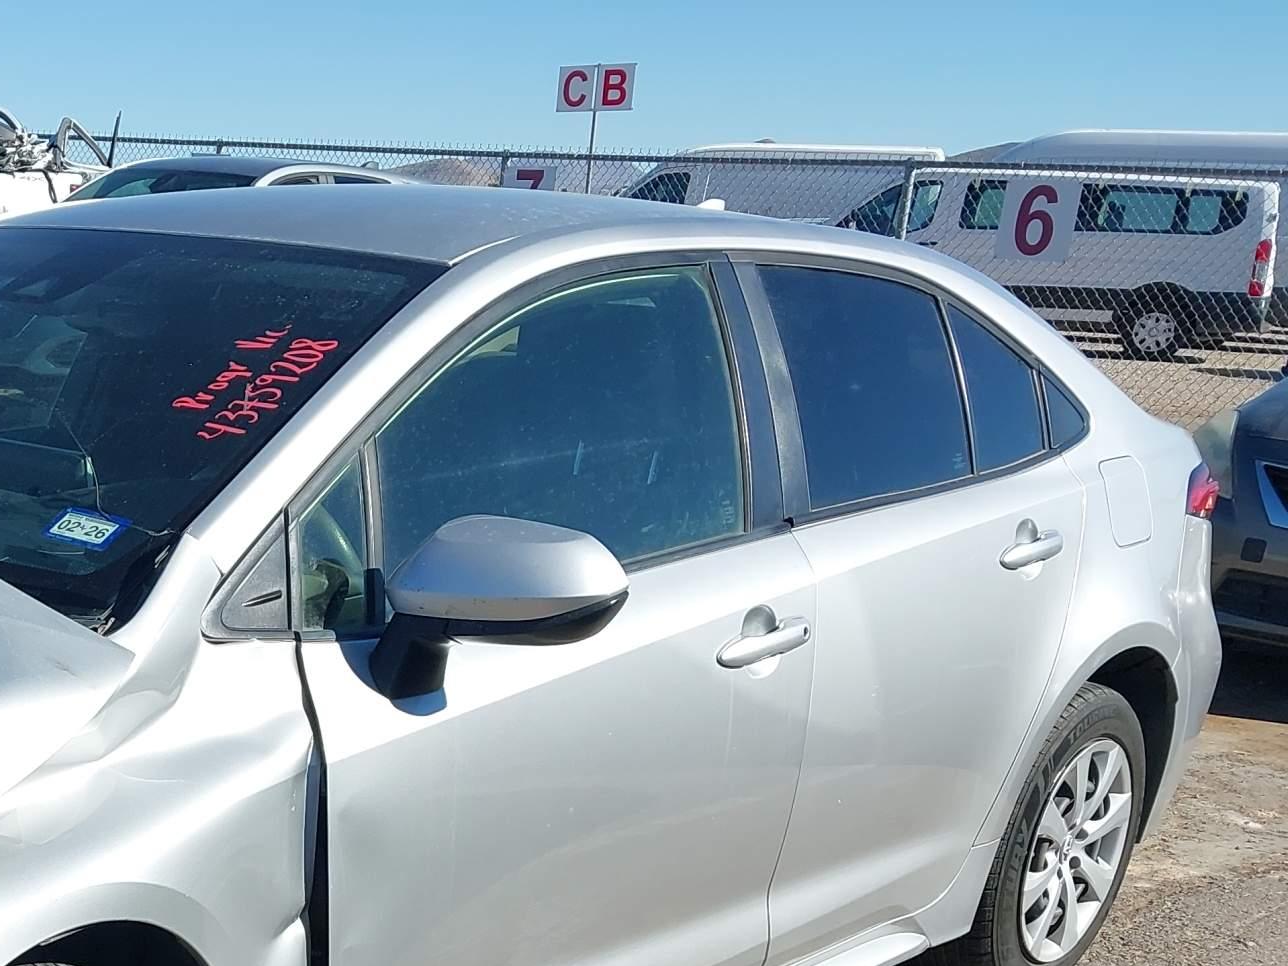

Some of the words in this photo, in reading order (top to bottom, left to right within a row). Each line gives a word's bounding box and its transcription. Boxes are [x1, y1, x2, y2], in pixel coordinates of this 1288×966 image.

[563, 70, 588, 107] C
[601, 69, 627, 106] B
[1015, 184, 1058, 256] 6
[196, 337, 339, 439] 43759208
